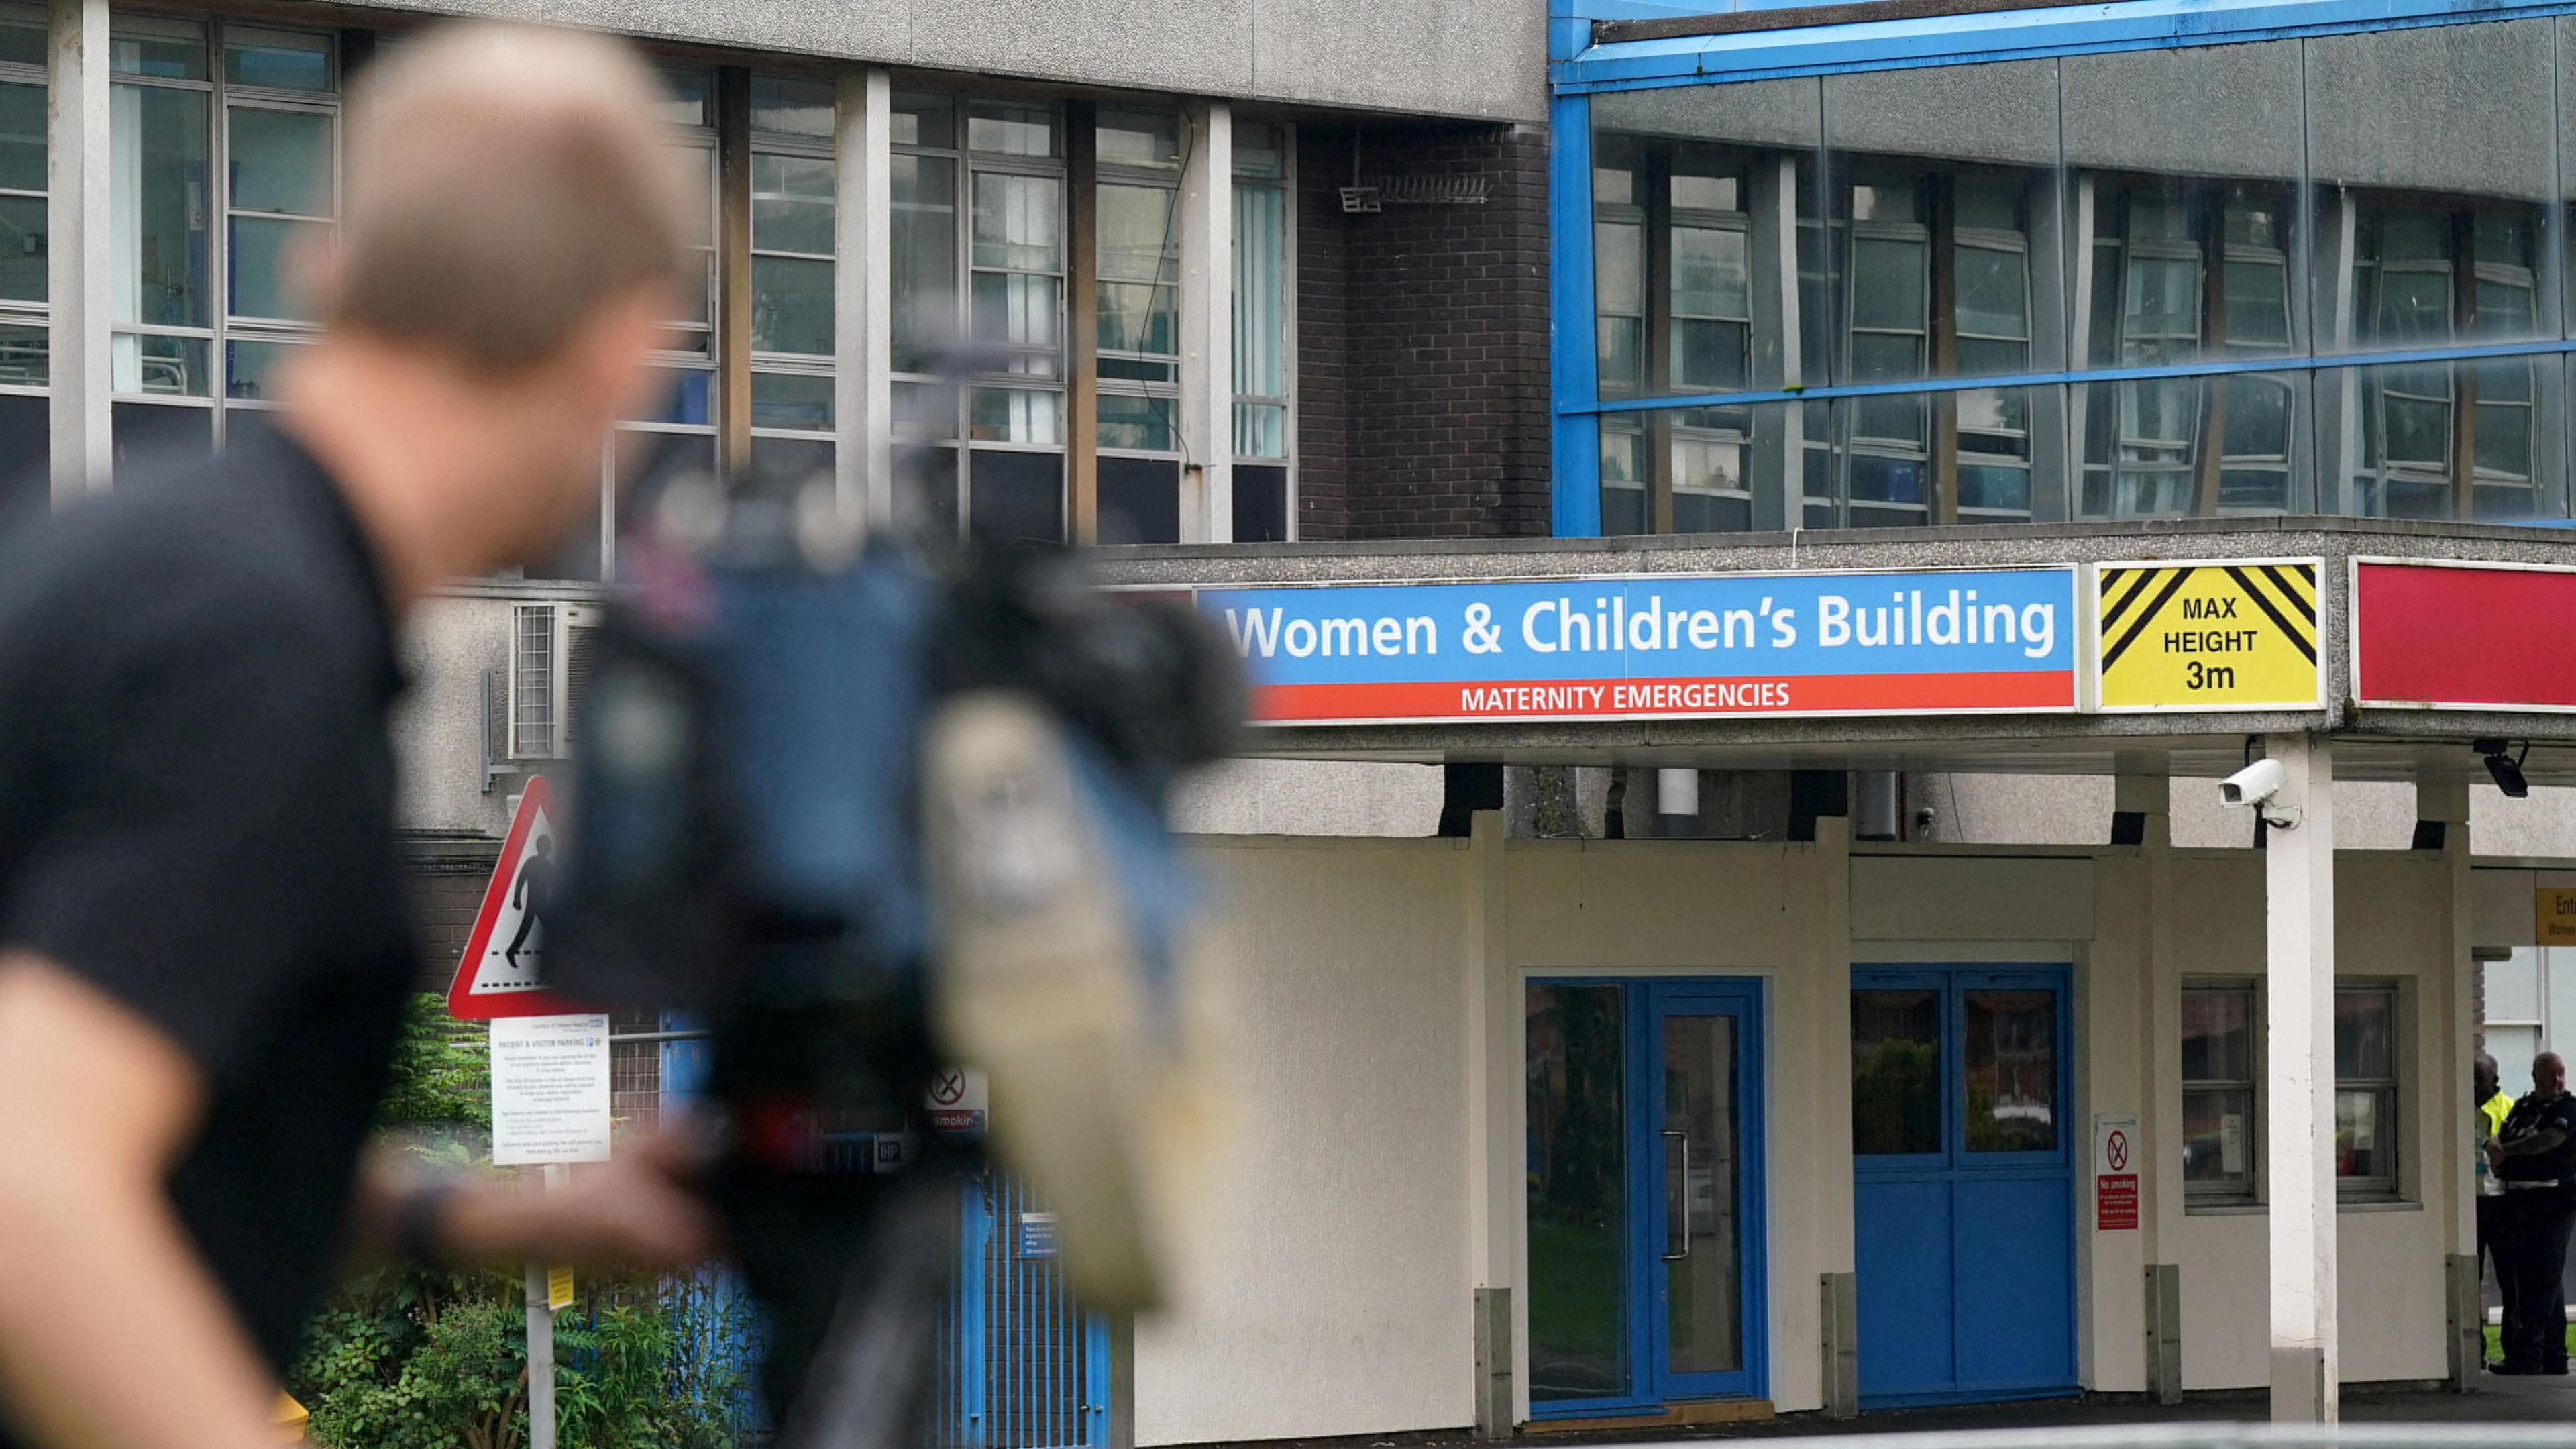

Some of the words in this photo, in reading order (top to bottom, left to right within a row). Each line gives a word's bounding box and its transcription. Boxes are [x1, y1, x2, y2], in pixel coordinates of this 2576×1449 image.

[2182, 598, 2237, 619] MAX
[1226, 607, 1438, 658] Women
[1462, 602, 1502, 653] &
[1521, 595, 1797, 653] Children’s
[1818, 588, 2055, 658] Building
[2164, 631, 2257, 653] HEIGHT
[2186, 661, 2235, 689] 3m
[1461, 686, 1605, 712] MATERNITY
[1613, 682, 1790, 709] EMERGENCIES
[498, 1040, 523, 1049] PATIENT
[532, 1039, 555, 1048] VISITOR
[557, 1038, 584, 1046] PARKING
[933, 1114, 974, 1126] smokin
[2100, 1179, 2109, 1189] No
[2111, 1179, 2136, 1191] smoking
